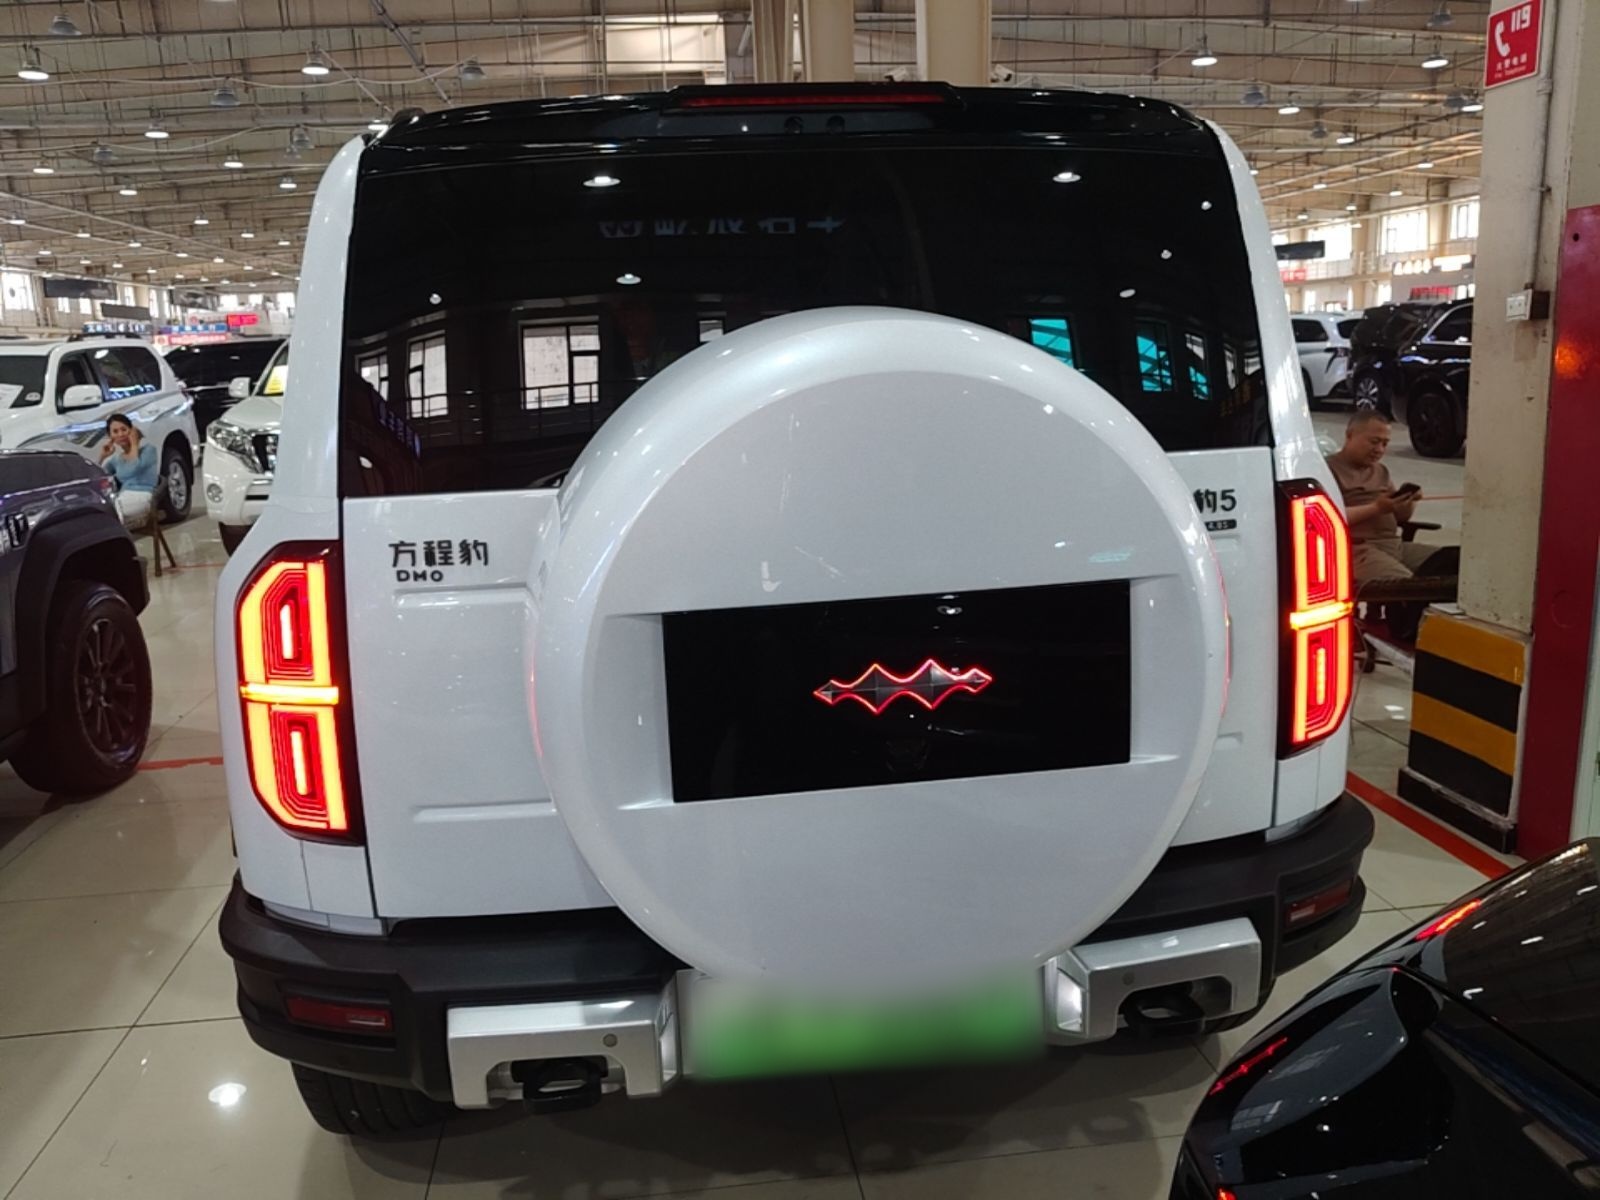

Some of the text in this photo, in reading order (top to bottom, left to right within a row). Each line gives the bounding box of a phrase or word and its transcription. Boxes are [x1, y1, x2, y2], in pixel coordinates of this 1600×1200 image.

[1511, 4, 1532, 33] 119
[388, 539, 489, 568] 方程豹
[396, 570, 444, 582] DMO
